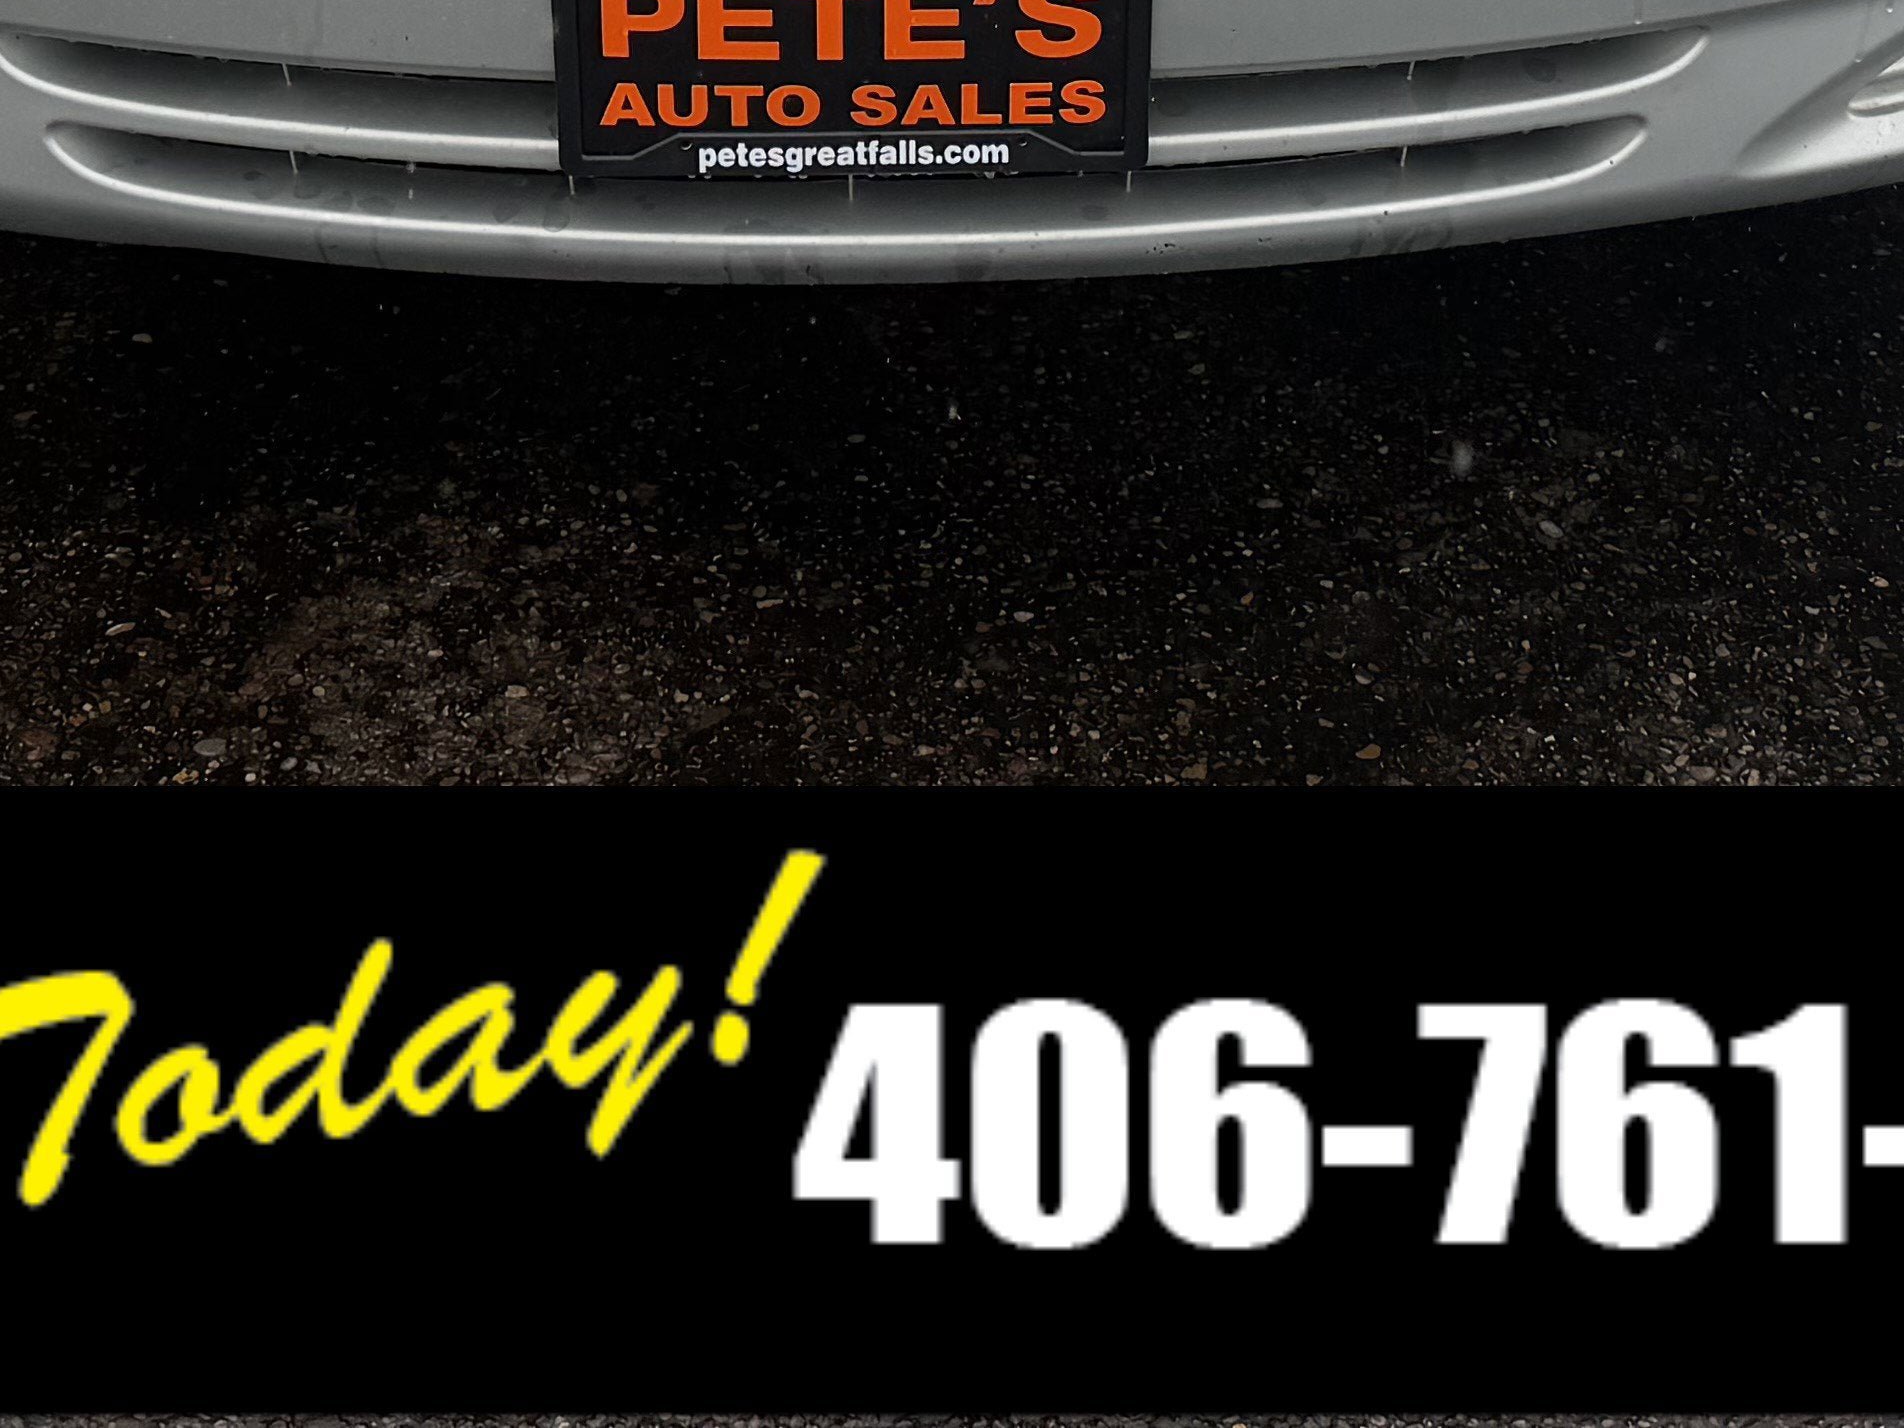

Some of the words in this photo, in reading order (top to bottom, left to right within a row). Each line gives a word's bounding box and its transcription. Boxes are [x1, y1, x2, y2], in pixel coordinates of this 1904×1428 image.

[599, 82, 822, 128] AUTO
[850, 79, 1108, 127] SALES
[698, 140, 1011, 173] petesgreatfalls.com
